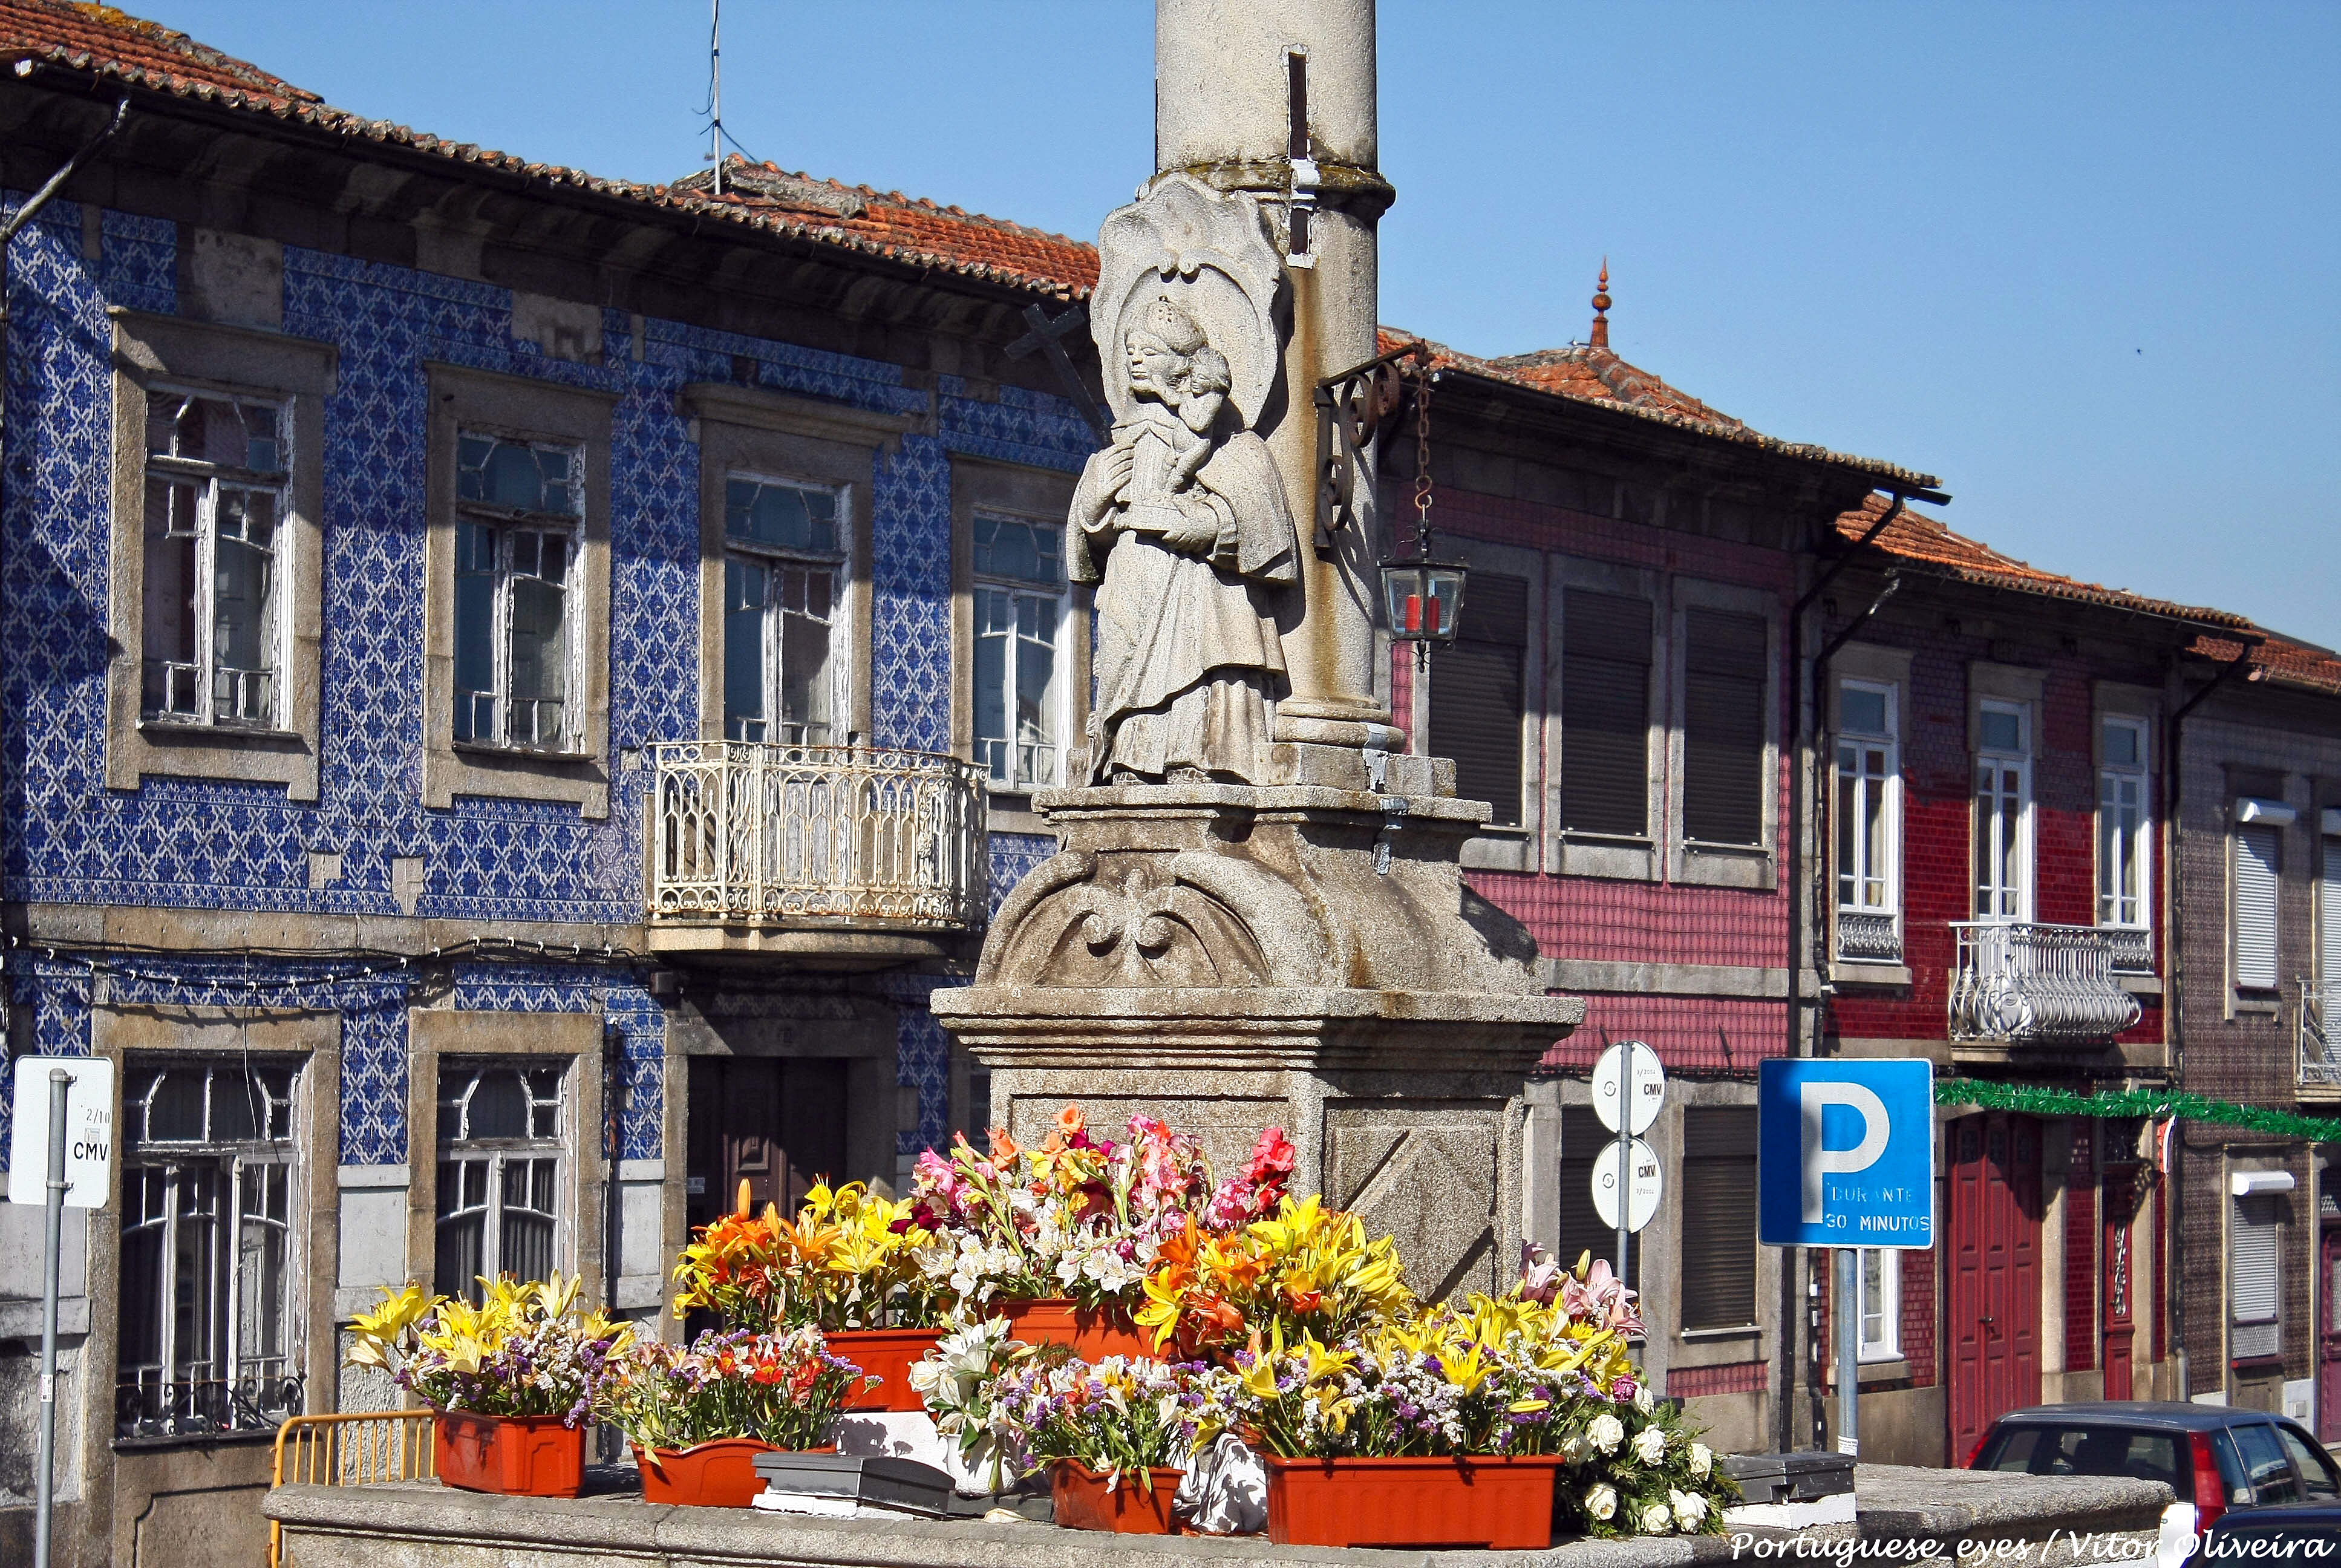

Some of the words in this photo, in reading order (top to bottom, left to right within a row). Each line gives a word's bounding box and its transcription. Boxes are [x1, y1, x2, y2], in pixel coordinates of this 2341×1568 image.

[1644, 1083, 1662, 1095] CMV
[86, 1108, 110, 1124] 2/10
[74, 1142, 108, 1161] CMV
[1800, 1082, 1890, 1223] P
[1638, 1165, 1656, 1178] CMV
[1832, 1186, 1913, 1203] DURNTE
[1826, 1213, 1847, 1229] 30
[1859, 1215, 1930, 1231] MINUTOS
